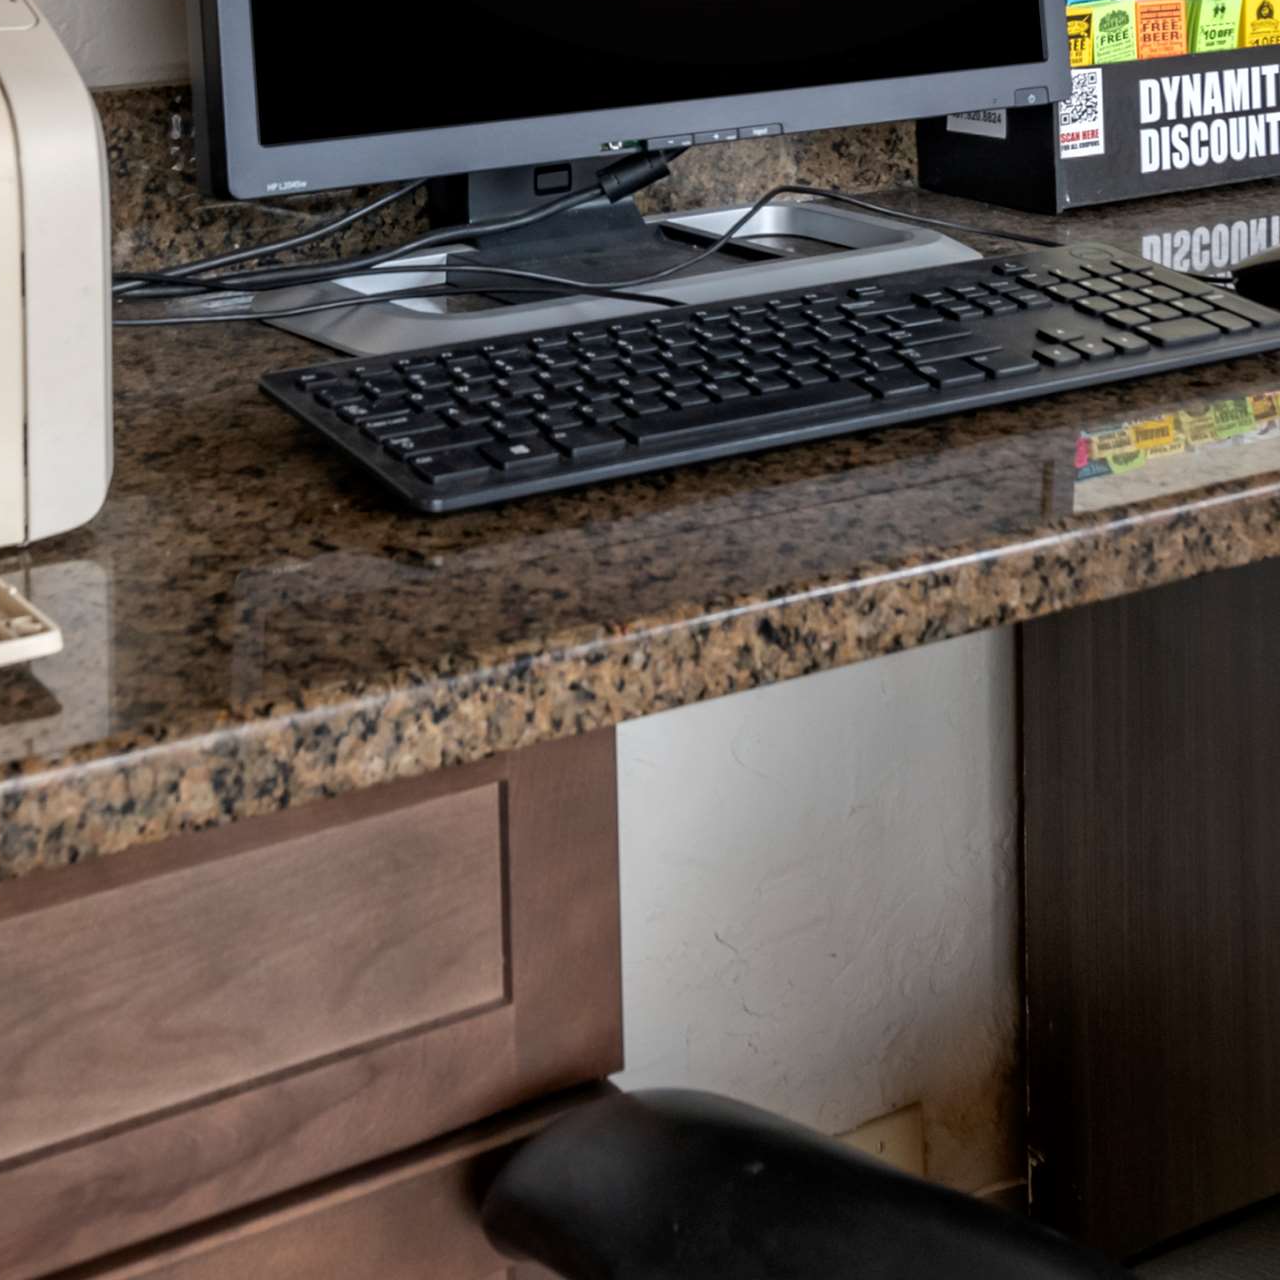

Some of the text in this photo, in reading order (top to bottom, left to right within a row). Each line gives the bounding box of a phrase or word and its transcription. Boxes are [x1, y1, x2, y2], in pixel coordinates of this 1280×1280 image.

[1142, 20, 1180, 32] FREE
[1100, 31, 1129, 45] FREE
[1143, 31, 1180, 42] BEER
[1217, 28, 1233, 38] OFF
[1069, 38, 1086, 51] EE
[1060, 129, 1099, 144] SCAN HERE
